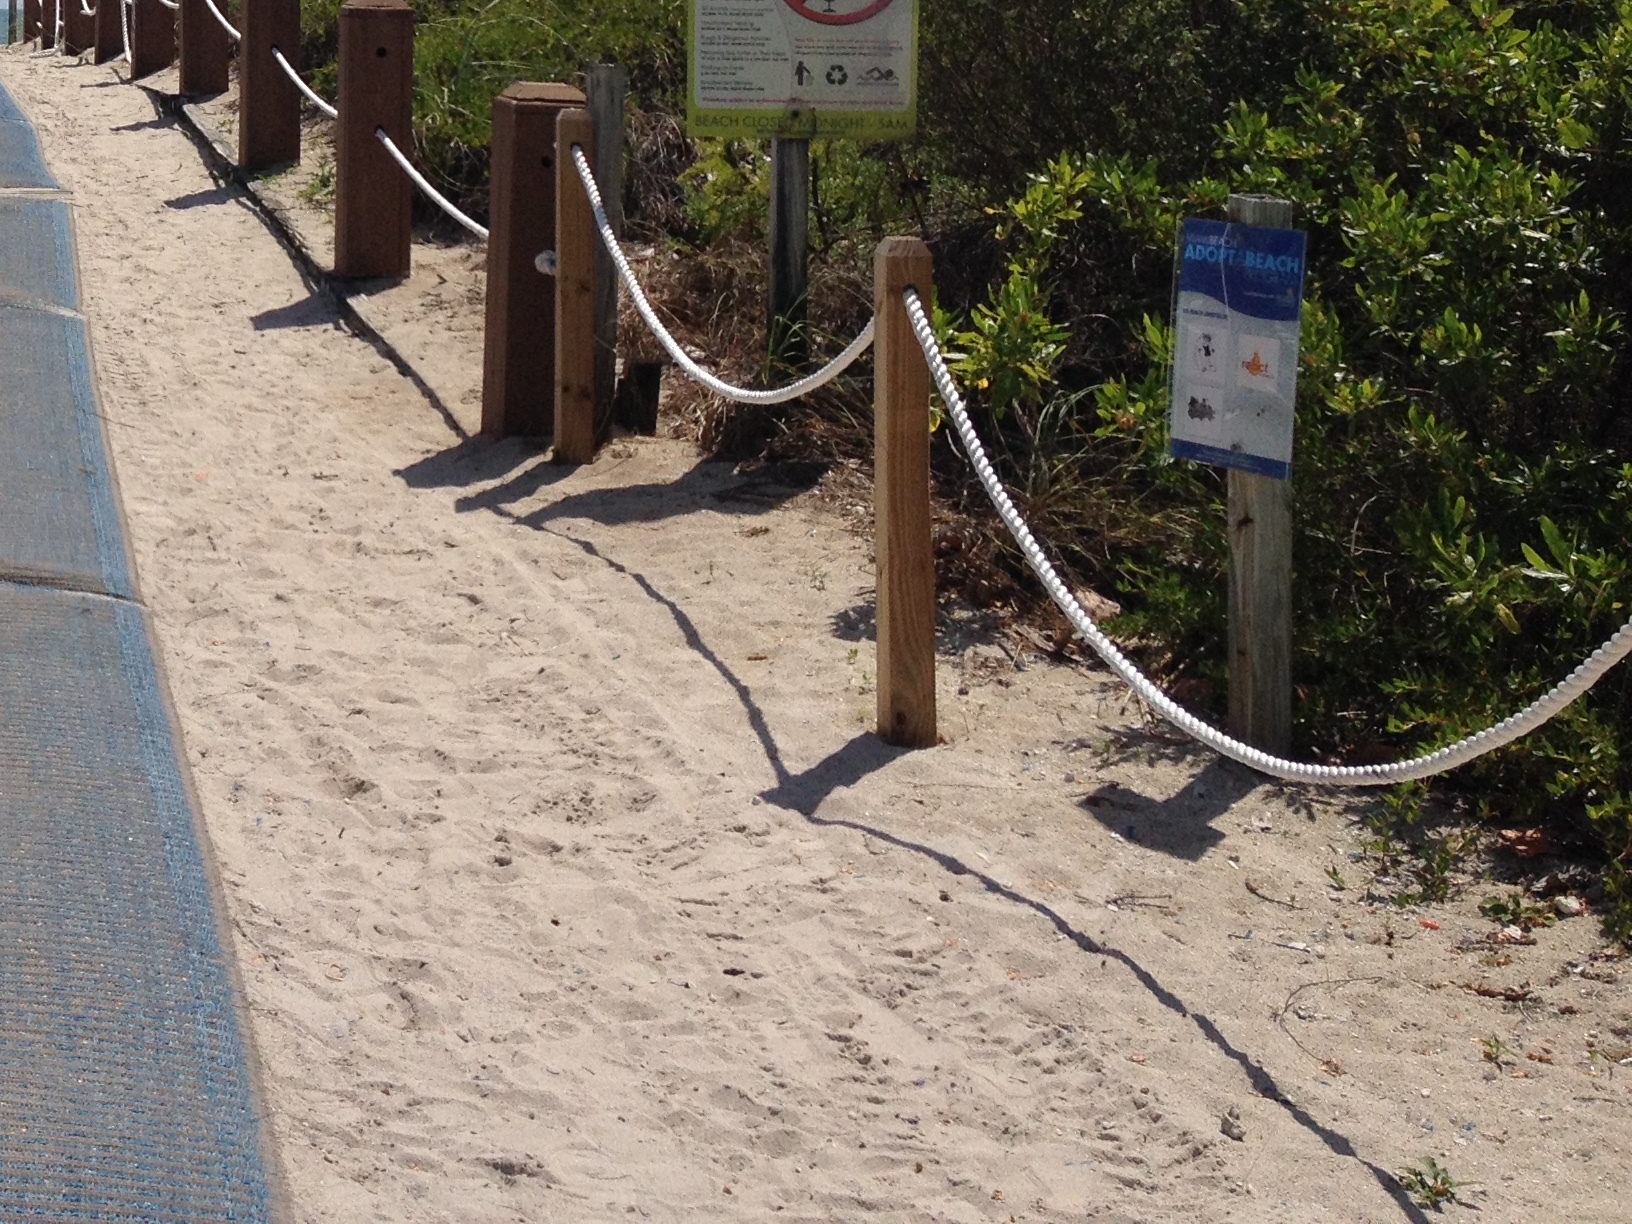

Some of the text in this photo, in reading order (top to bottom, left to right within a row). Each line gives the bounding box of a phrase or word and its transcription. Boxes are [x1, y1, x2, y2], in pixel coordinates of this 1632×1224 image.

[695, 115, 739, 127] BEACH
[1184, 242, 1299, 274] ADOPT BEACH
